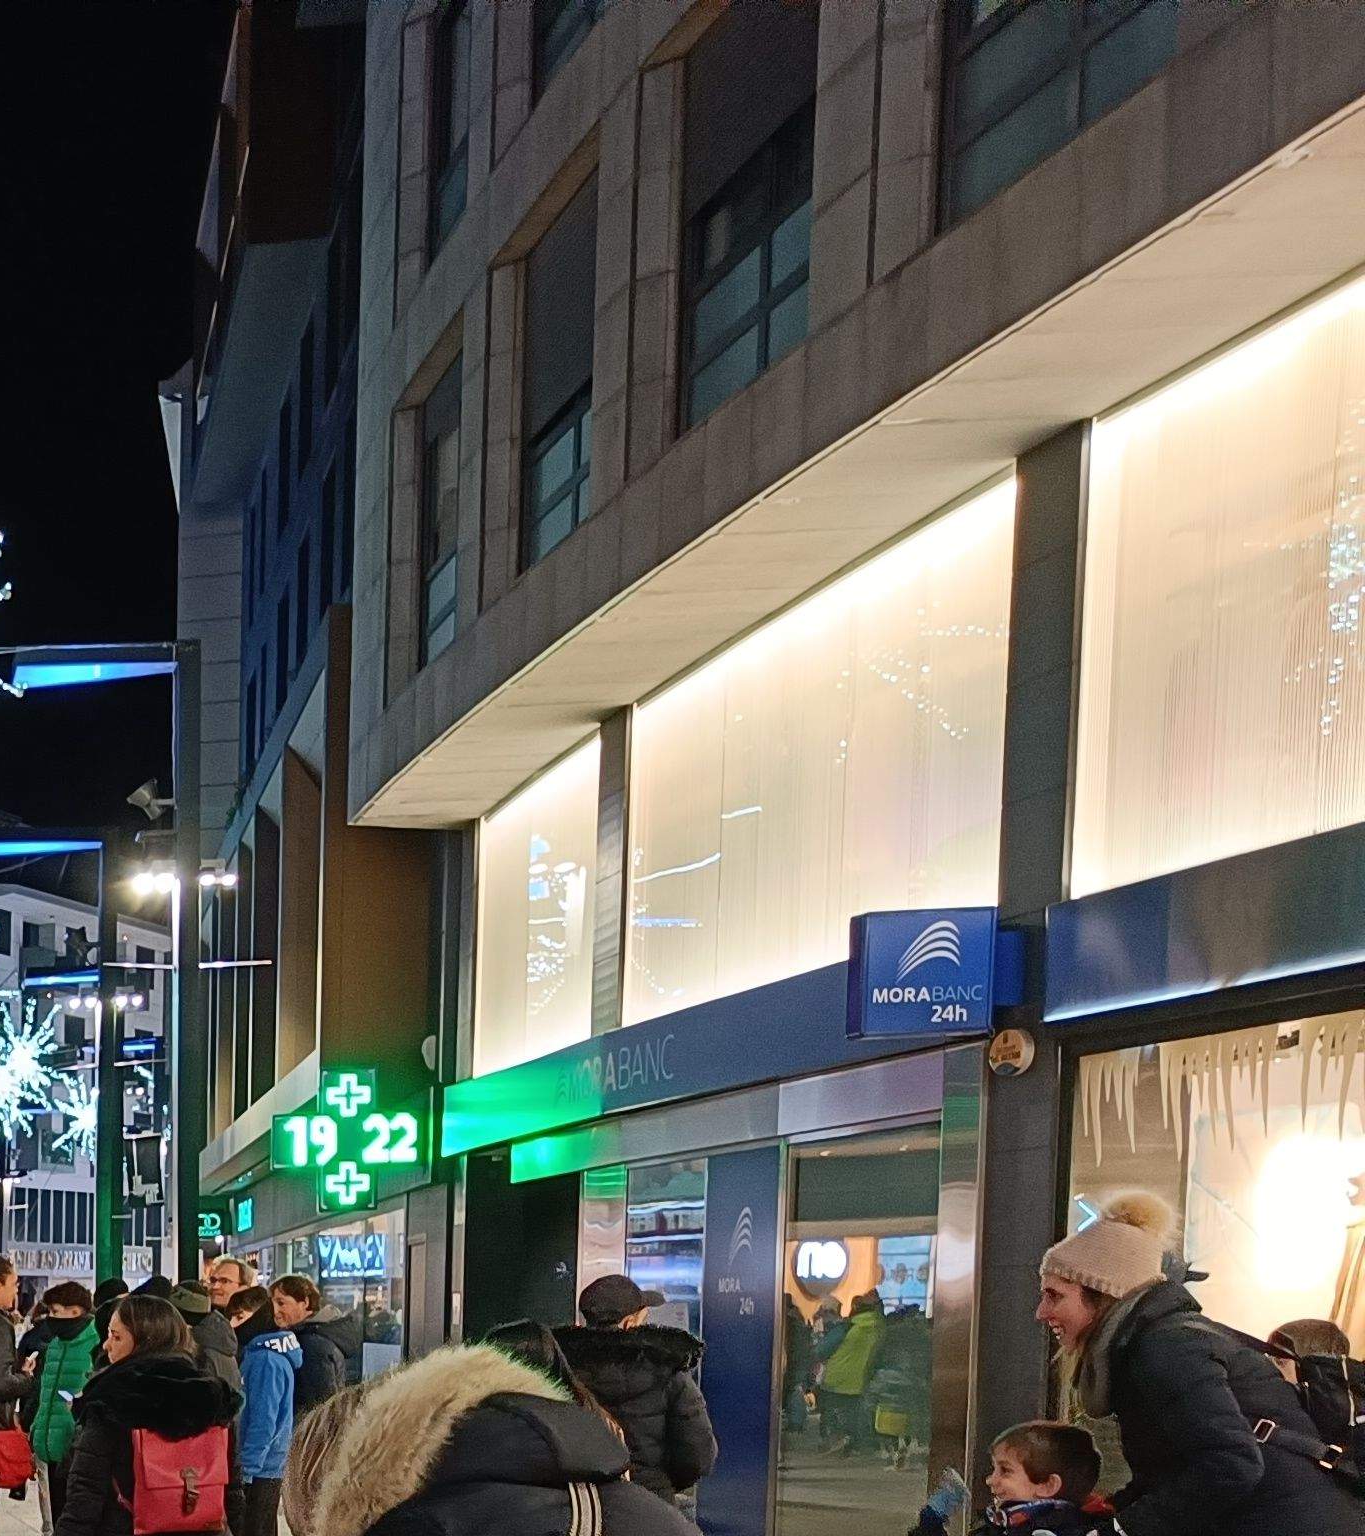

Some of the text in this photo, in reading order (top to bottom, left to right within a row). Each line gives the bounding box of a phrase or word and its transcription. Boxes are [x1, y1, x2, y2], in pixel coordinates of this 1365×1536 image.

[872, 984, 984, 1004] MORABANC
[930, 1004, 968, 1023] 24h
[283, 1112, 418, 1168] 19 22
